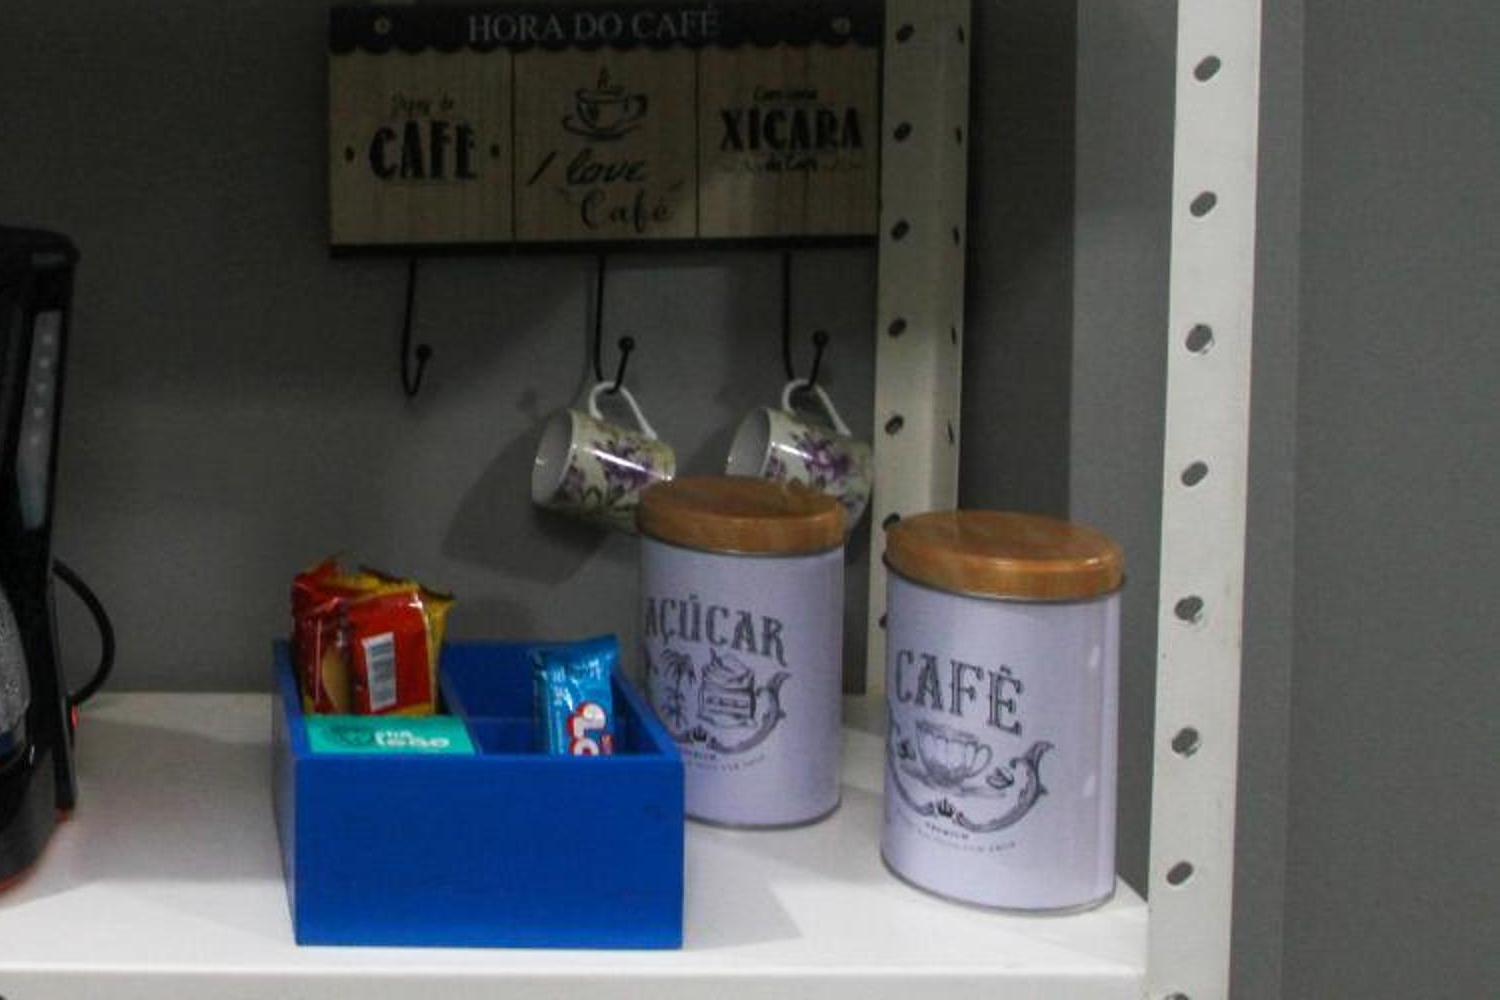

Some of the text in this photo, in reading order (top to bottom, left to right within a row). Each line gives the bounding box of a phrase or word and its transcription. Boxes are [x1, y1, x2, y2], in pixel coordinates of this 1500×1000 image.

[468, 2, 722, 42] HORA DO CAFÉ
[566, 147, 650, 186] love
[644, 594, 789, 667] AÇÚCAR
[896, 649, 1024, 736] CAFÉ
